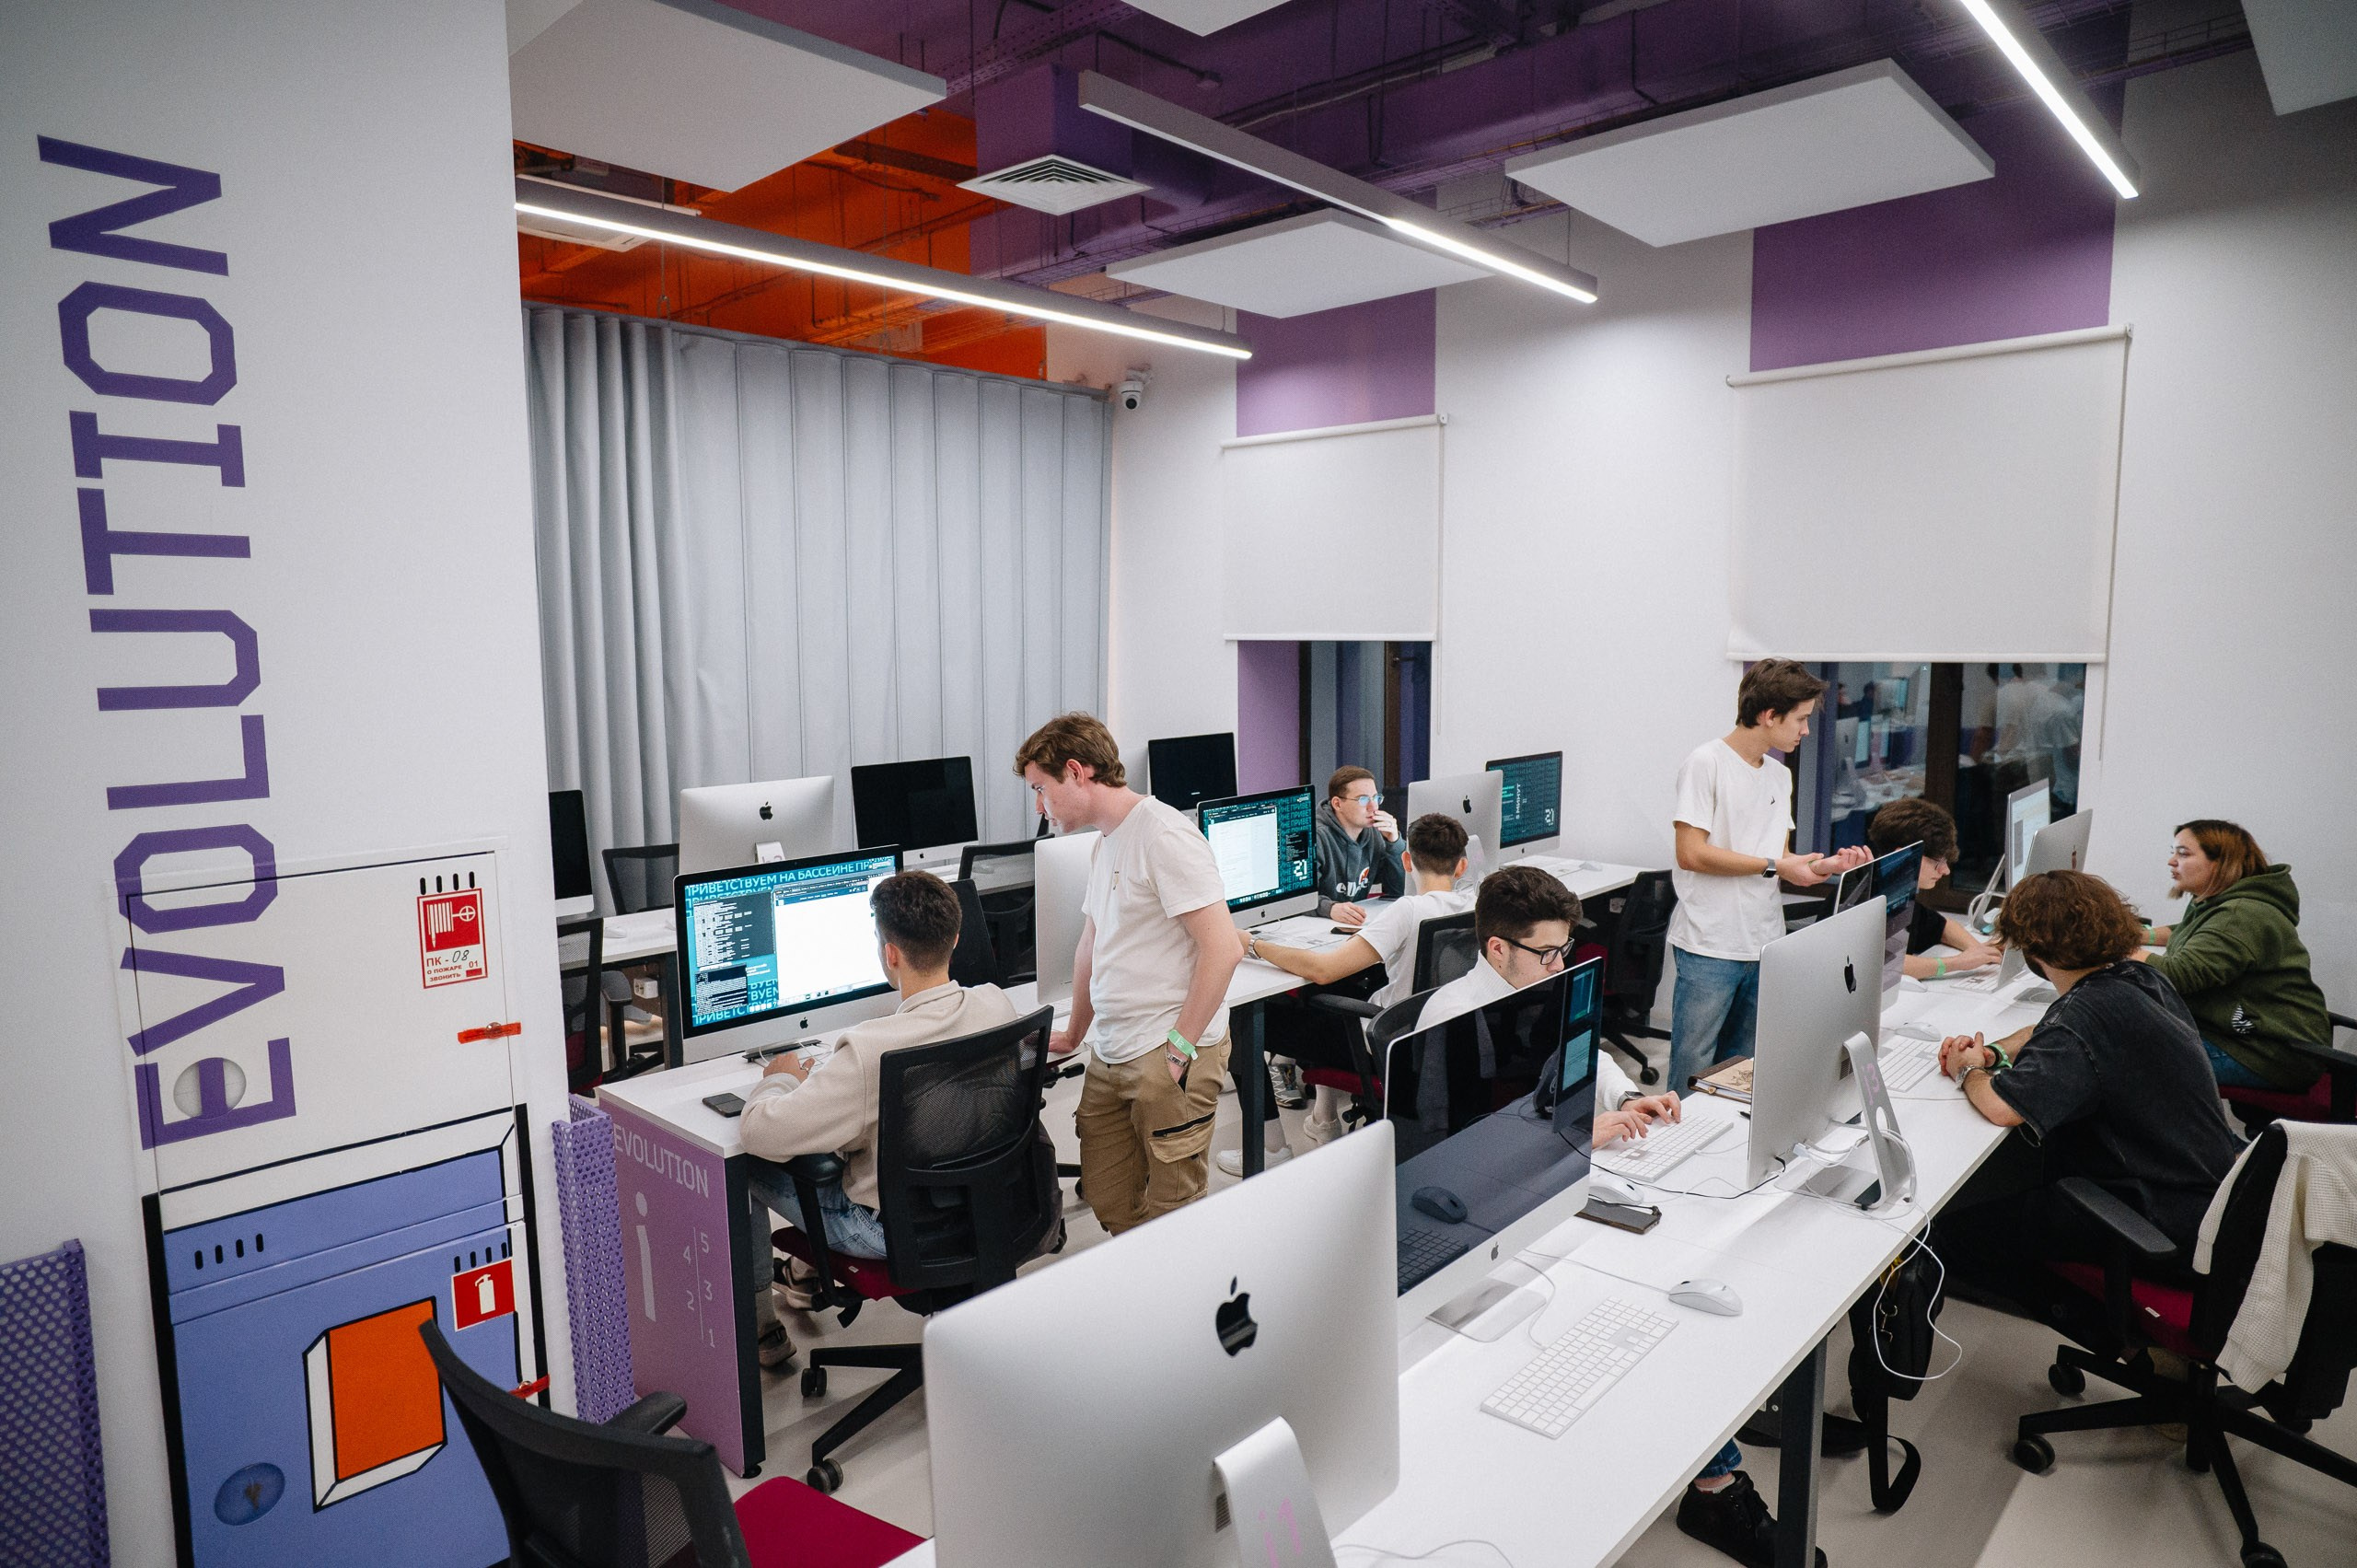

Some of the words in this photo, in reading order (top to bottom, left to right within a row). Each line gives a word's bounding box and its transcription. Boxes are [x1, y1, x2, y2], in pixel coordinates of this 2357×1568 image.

[37, 134, 296, 1150] EVOLUTION
[780, 873, 795, 884] НА
[855, 861, 869, 871] ПР
[1293, 859, 1307, 877] 21
[430, 973, 461, 982] ЗВОНИТЬ
[434, 965, 462, 974] ПОЖАРЕ
[613, 1122, 709, 1198] EVOLUTION
[683, 1246, 691, 1264] 4
[701, 1232, 709, 1253] 5
[687, 1290, 694, 1311] 2
[704, 1280, 713, 1301] 3
[708, 1329, 715, 1348] 1
